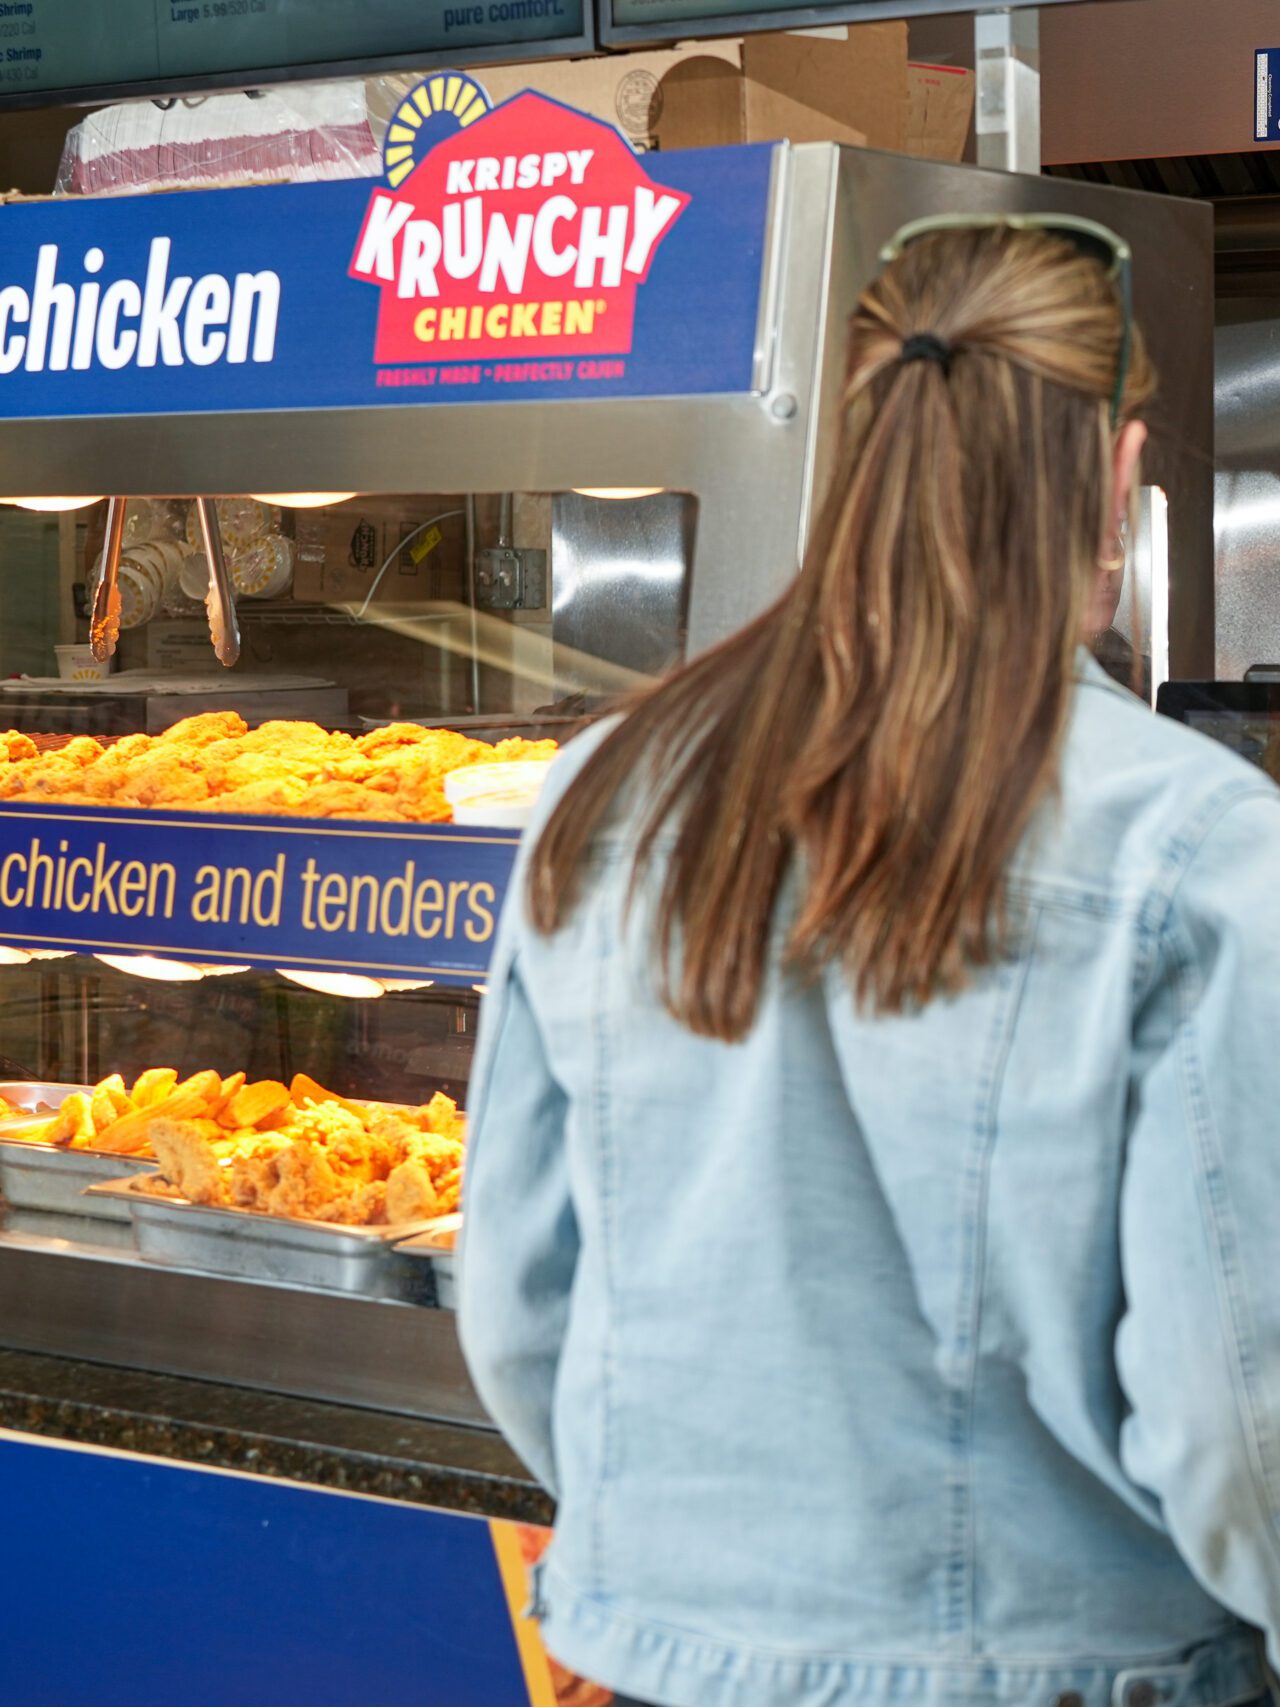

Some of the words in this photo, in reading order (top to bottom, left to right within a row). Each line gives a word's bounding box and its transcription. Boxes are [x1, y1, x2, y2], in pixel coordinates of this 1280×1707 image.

[170, 7, 200, 23] Large
[443, 5, 484, 32] pure
[6, 46, 42, 63] Shrimp
[446, 149, 594, 194] KRISPY
[354, 185, 681, 299] KRUNCHY
[0, 236, 280, 374] chicken
[0, 838, 176, 919] chicken
[191, 853, 286, 927] and
[301, 859, 496, 943] tenders
